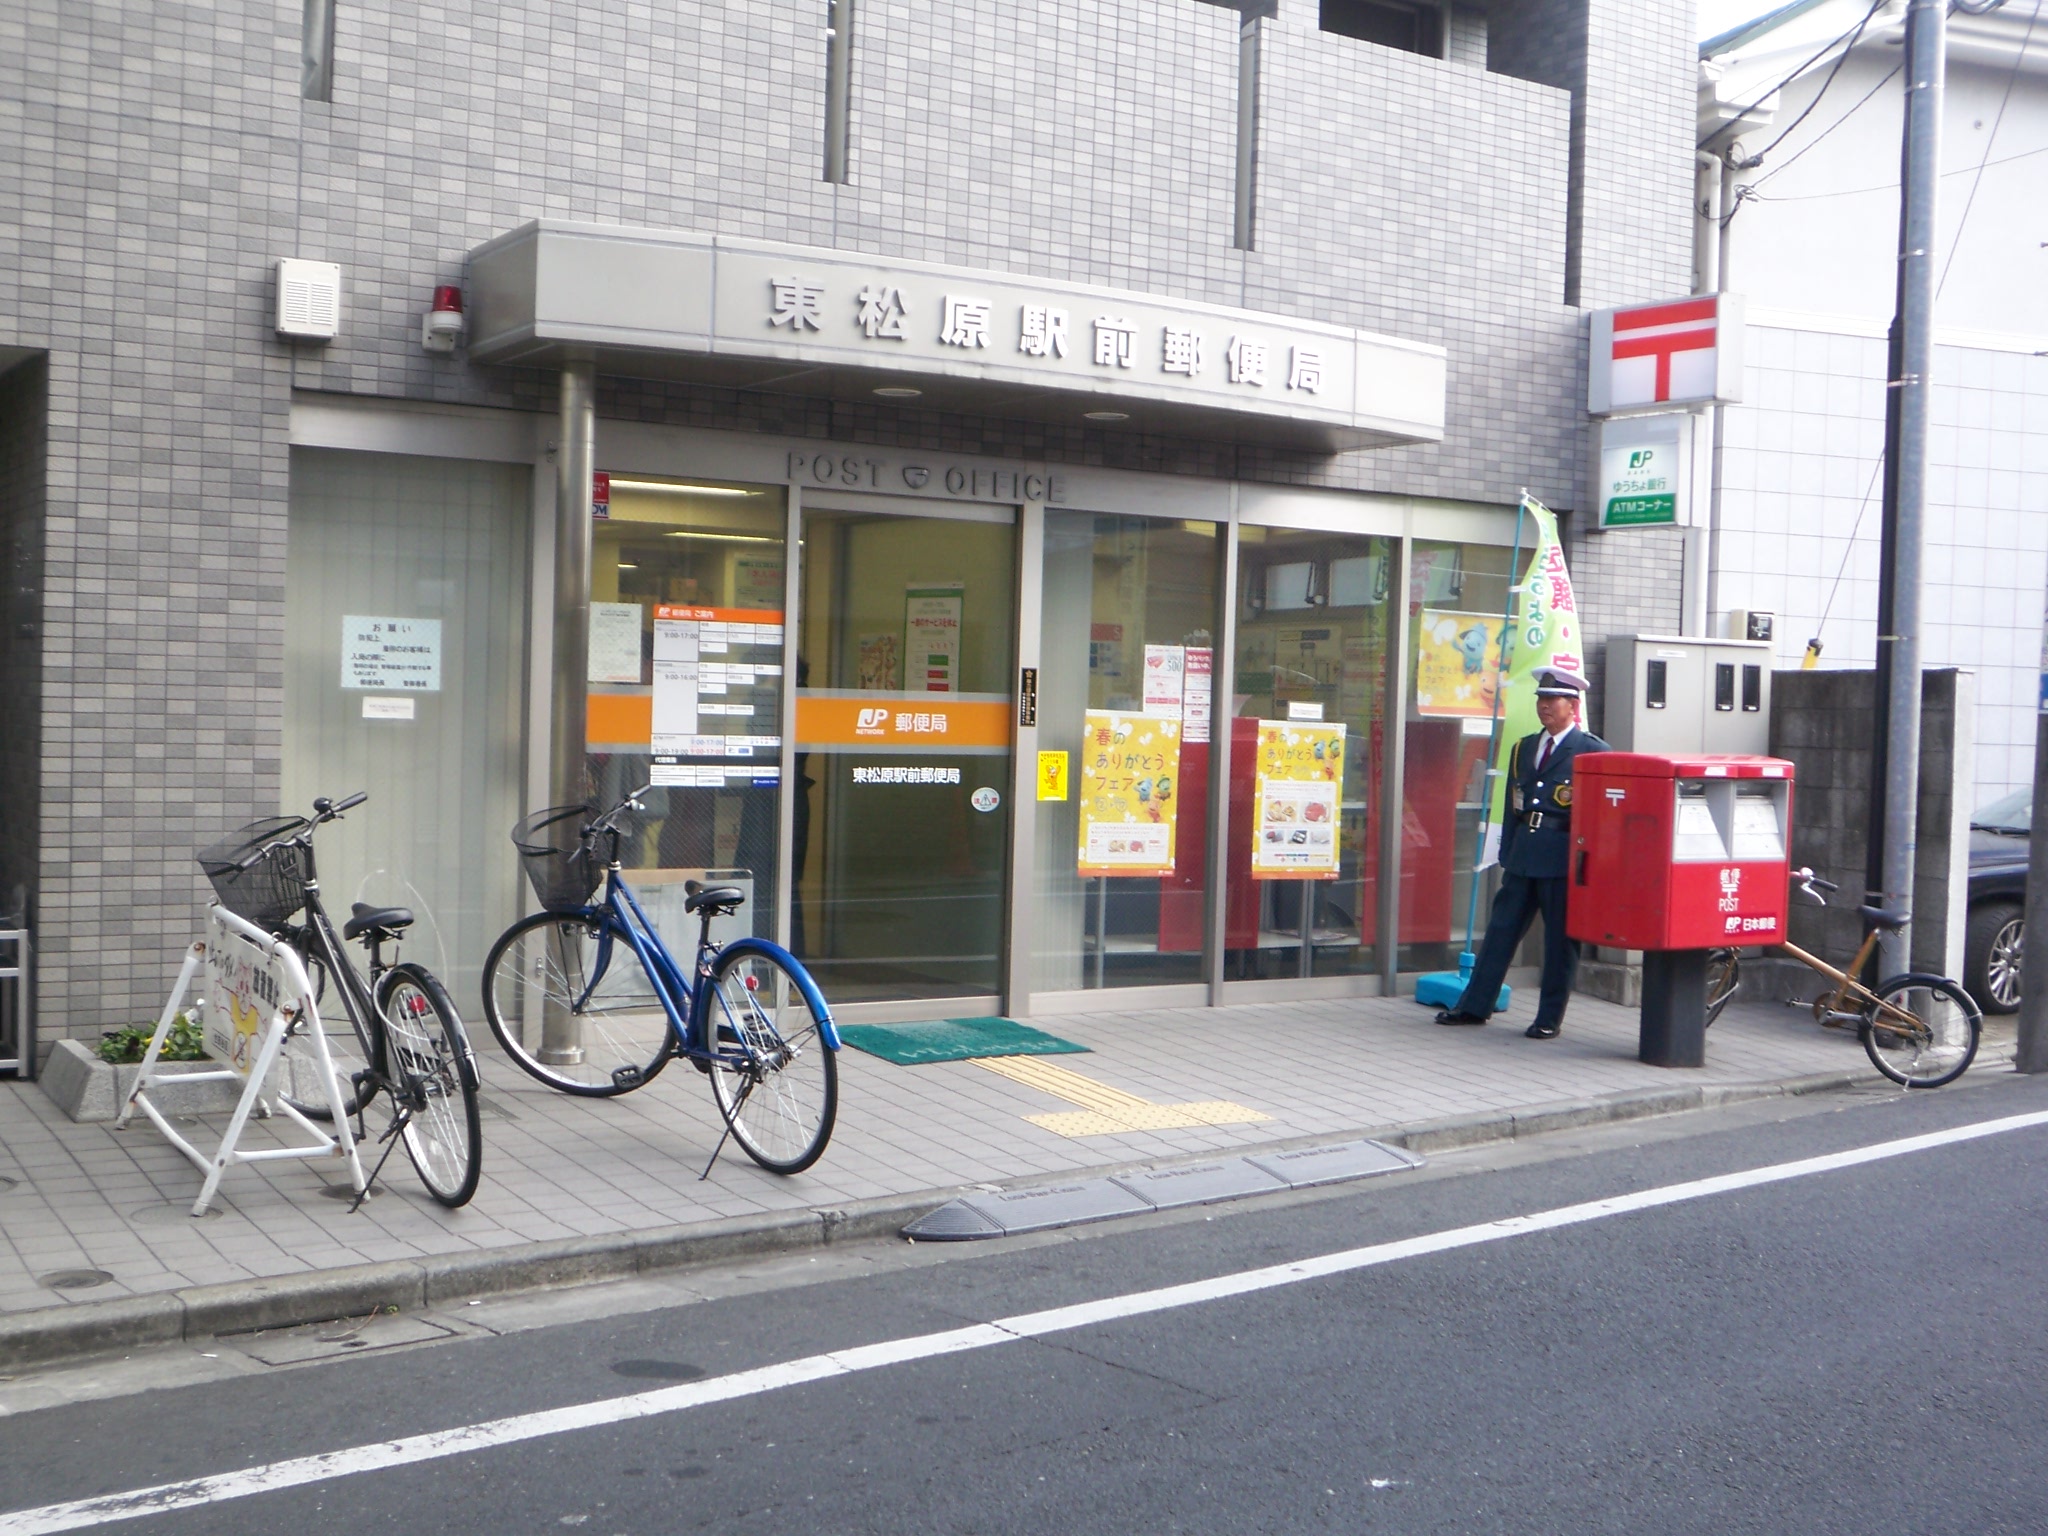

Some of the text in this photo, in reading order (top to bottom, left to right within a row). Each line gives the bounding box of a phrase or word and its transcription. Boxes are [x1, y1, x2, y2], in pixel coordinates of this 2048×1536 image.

[769, 273, 1325, 394] 東松原駅前郵便局
[1629, 450, 1653, 469] JP
[786, 452, 1066, 503] POST OFFICE
[1613, 478, 1667, 493] ゆうちょ銀行
[1613, 499, 1671, 513] ATMコーナー
[856, 708, 888, 728] JP
[895, 713, 947, 733] 郵便局
[1095, 727, 1125, 746] 春の
[1266, 730, 1287, 744] 春の
[1096, 753, 1165, 770] ありがとう
[1266, 749, 1312, 760] ありがとう
[852, 766, 961, 784] 東松原駅前郵便局
[1266, 764, 1292, 775] フェア
[1095, 777, 1134, 791] フェア
[1720, 867, 1741, 884] 郵便
[1718, 898, 1740, 912] POST
[1743, 917, 1776, 931] 日本郵便
